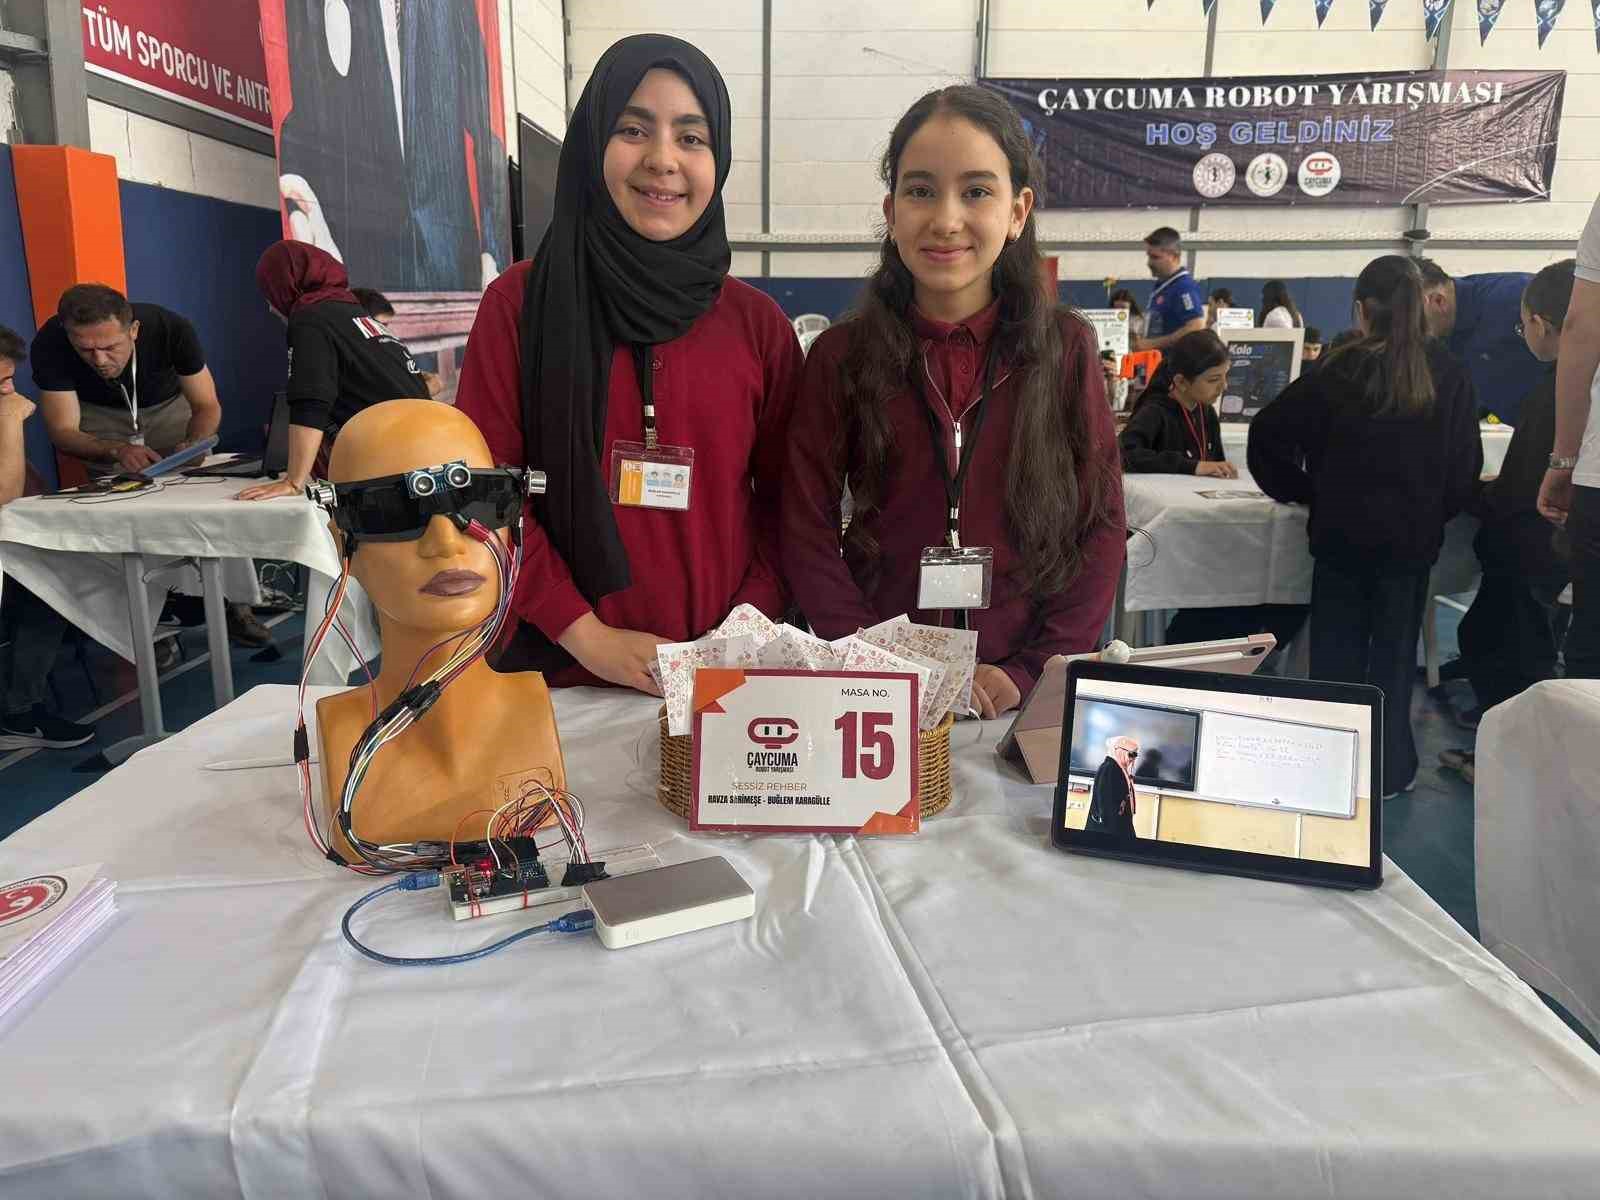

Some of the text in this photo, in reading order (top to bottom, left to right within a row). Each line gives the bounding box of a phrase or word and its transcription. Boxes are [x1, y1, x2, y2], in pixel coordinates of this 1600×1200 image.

[83, 5, 132, 60] TÜM
[136, 30, 209, 90] SPORCU
[212, 63, 233, 101] VE
[1038, 81, 1504, 116] ÇAYCUMA ROBOT YARIŞMASI
[1146, 115, 1394, 150] HOŞ GELDİNİZ
[841, 688, 870, 697] MASA
[834, 711, 895, 780] 15
[747, 752, 798, 768] ÇAYCUMA
[731, 780, 807, 791] SESSİZ REHBER
[795, 794, 831, 805] KARAGÜLLE
